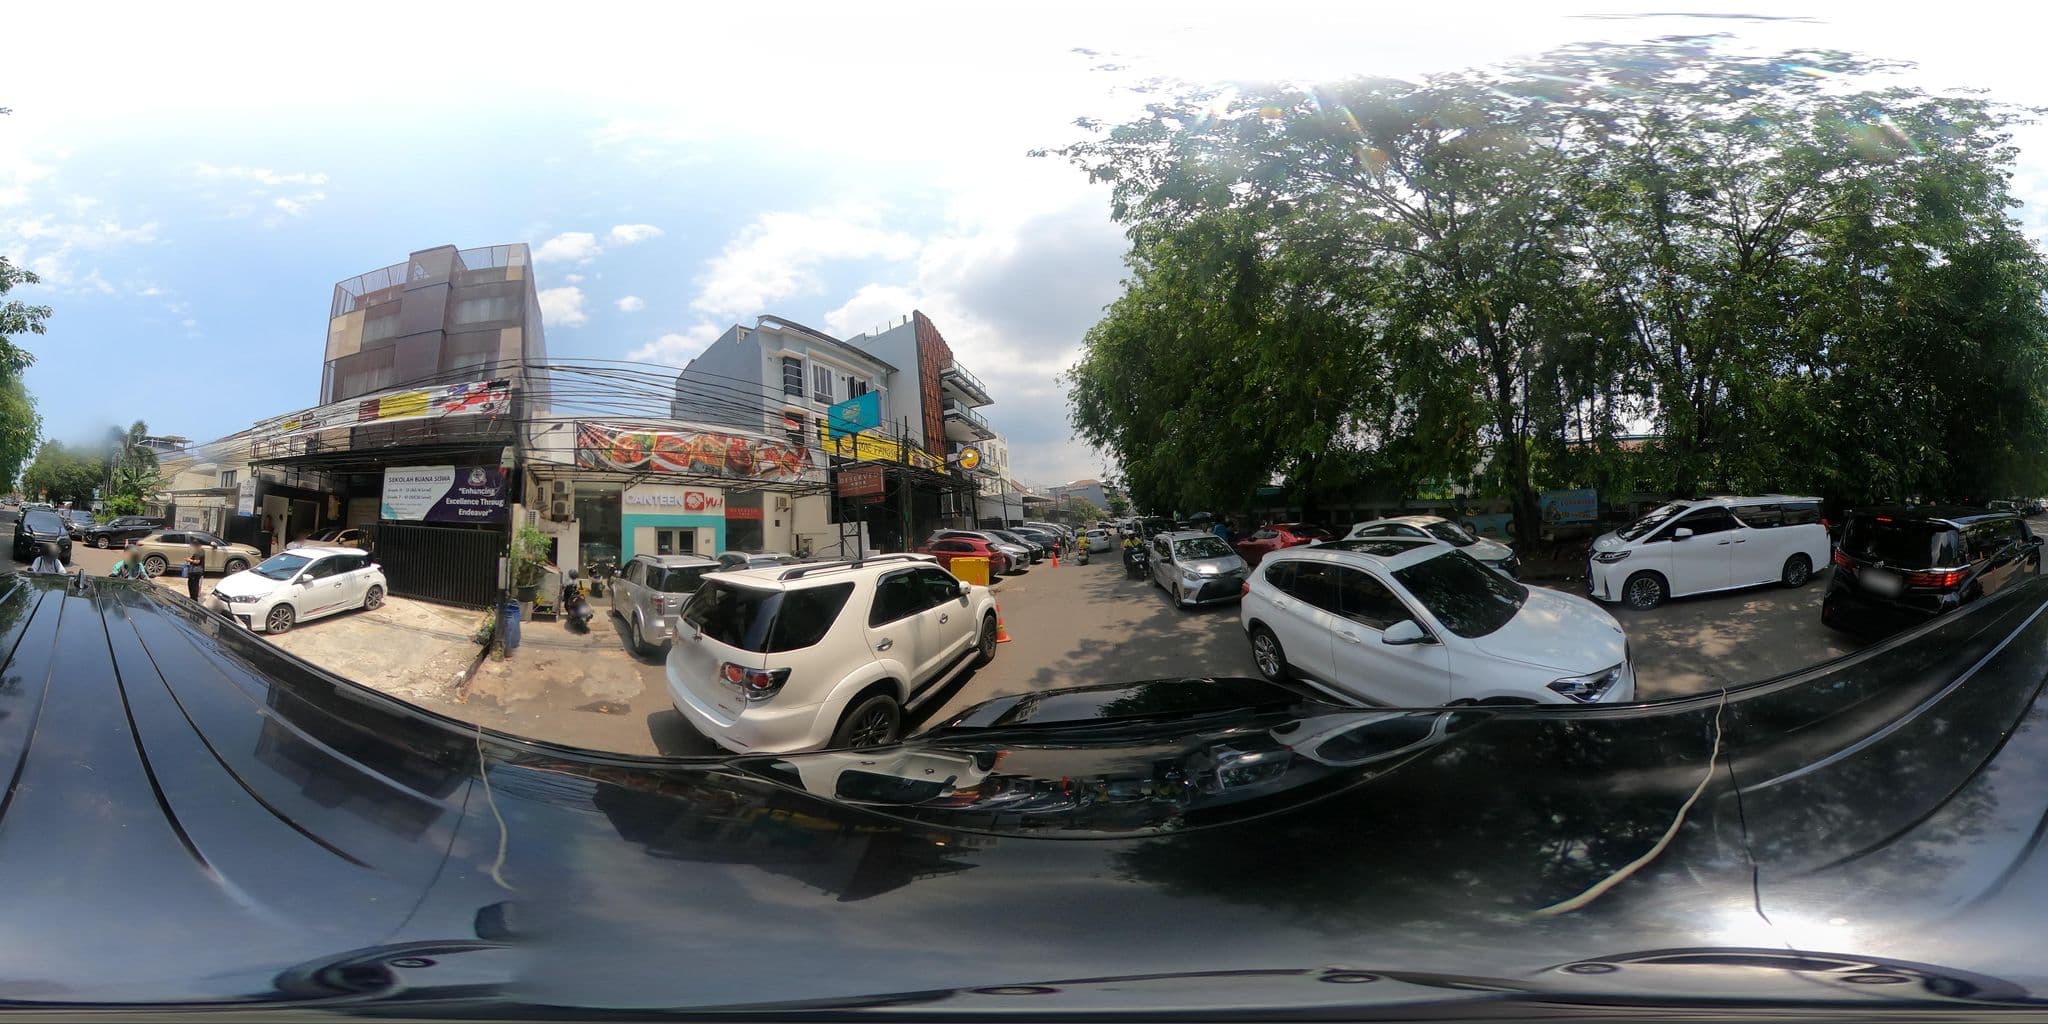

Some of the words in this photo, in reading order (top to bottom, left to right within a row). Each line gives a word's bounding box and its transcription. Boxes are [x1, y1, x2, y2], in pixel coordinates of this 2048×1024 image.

[445, 497, 480, 506] Excellence
[480, 498, 504, 508] Throug
[624, 495, 683, 508] CANTEEN
